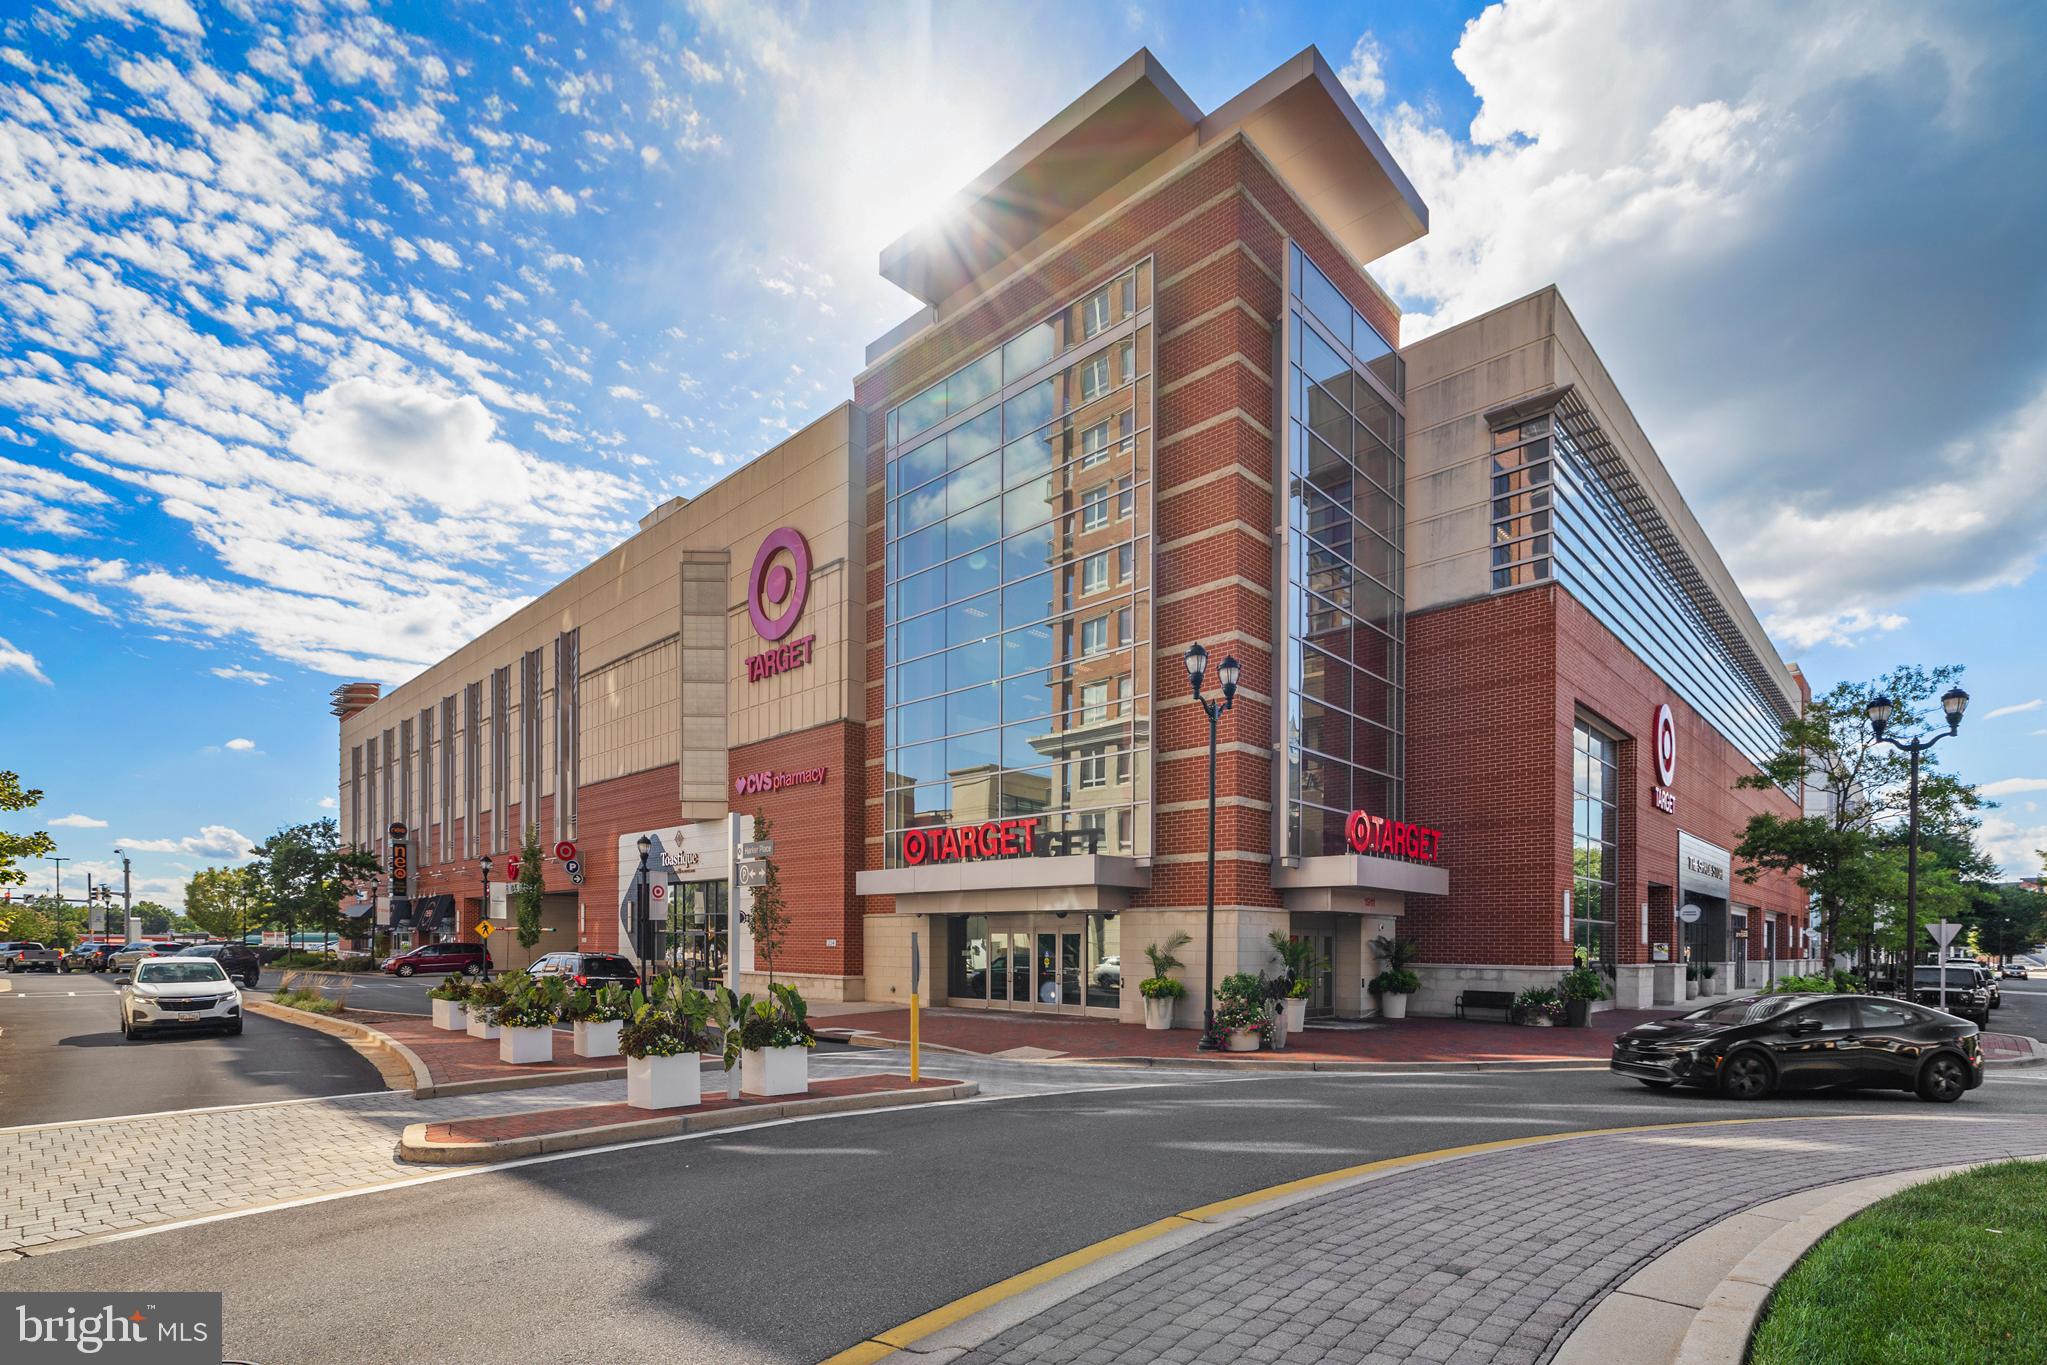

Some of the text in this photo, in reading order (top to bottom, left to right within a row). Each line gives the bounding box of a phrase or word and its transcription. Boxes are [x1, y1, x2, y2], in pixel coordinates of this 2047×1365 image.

[745, 634, 816, 683] TARGET
[746, 767, 826, 794] CVS pharmacy
[1655, 786, 1676, 814] TARGET
[927, 818, 1039, 861] TARGET
[1371, 816, 1443, 862] TARGET
[569, 862, 577, 871] P
[661, 850, 699, 868] Toastique
[742, 868, 747, 880] P
